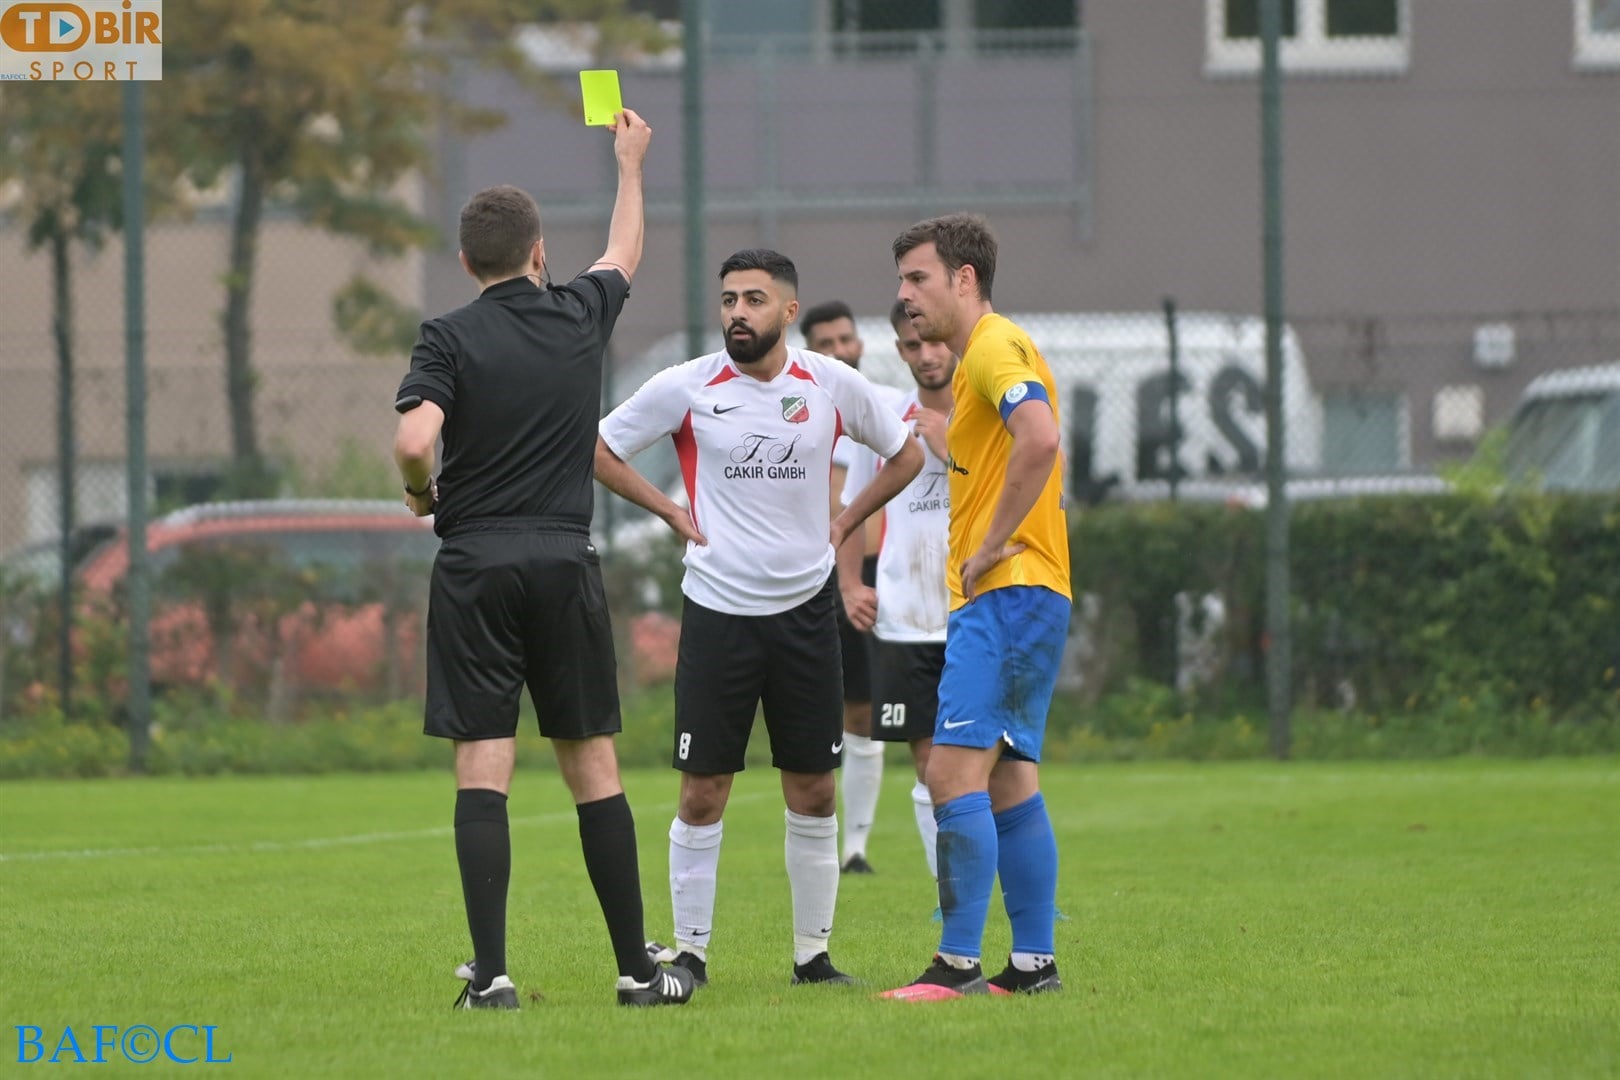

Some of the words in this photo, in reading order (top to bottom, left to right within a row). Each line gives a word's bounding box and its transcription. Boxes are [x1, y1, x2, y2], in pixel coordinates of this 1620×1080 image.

[724, 466, 764, 480] CAKIR
[767, 466, 806, 480] GMBH
[909, 499, 941, 513] CAKIR
[881, 703, 906, 726] 20
[679, 732, 692, 761] 8
